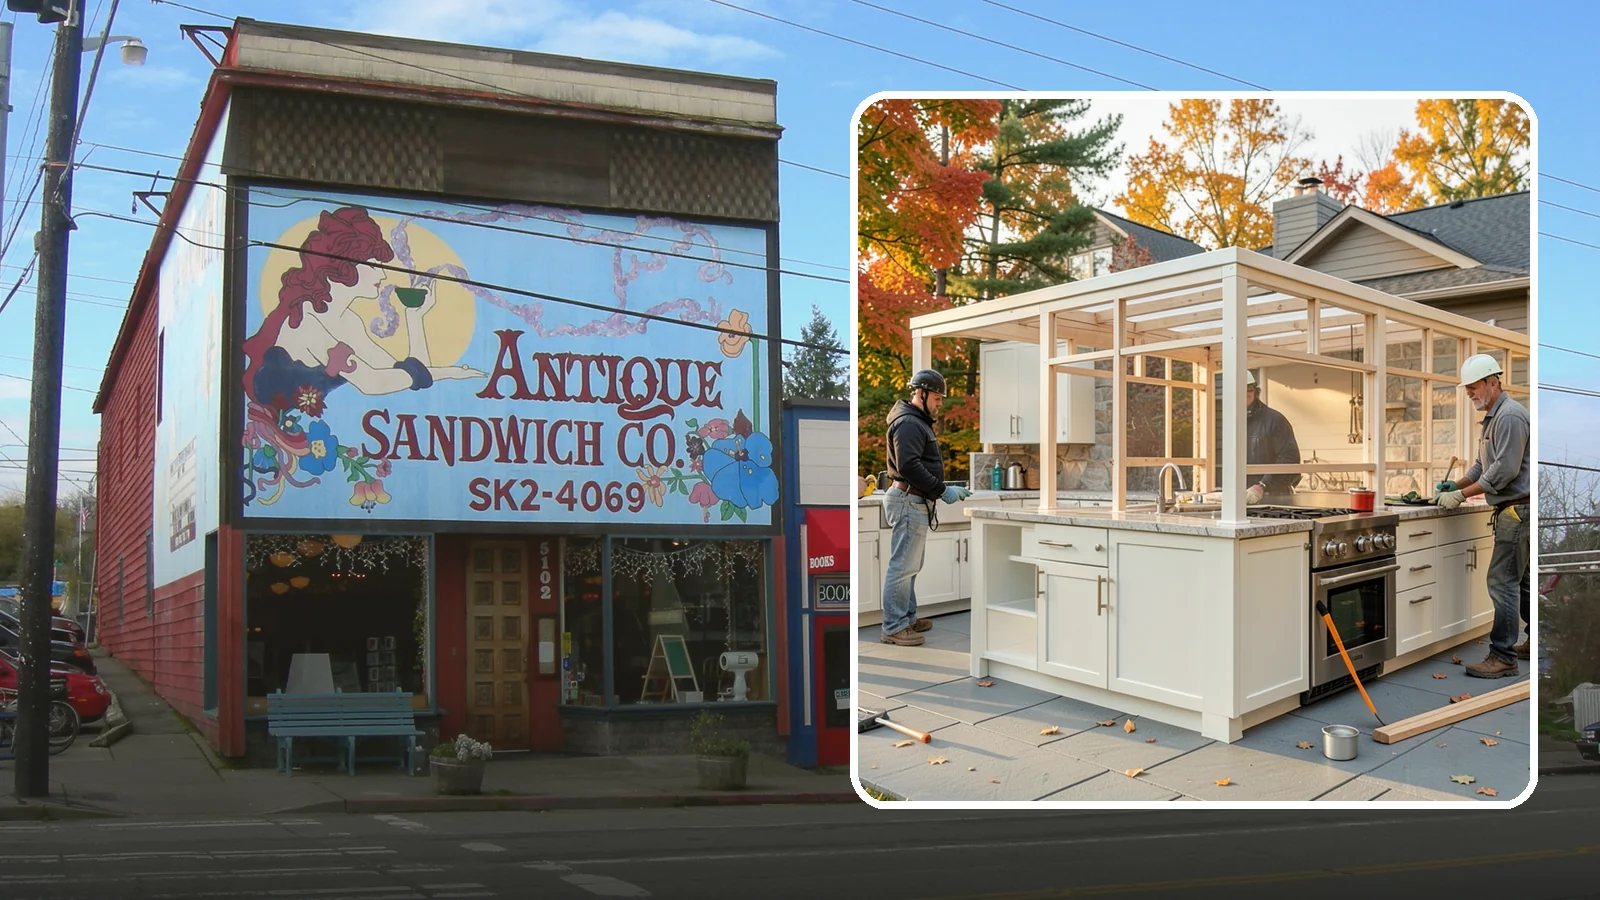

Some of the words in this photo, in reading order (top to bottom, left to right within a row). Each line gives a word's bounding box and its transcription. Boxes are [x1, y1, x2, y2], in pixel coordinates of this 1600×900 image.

[476, 329, 724, 421] ANTIQUE
[361, 409, 604, 467] SANDWICH
[617, 422, 685, 469] CO.
[468, 477, 646, 513] SK2-4069
[540, 541, 551, 600] 5102
[809, 555, 835, 569] BOOKS
